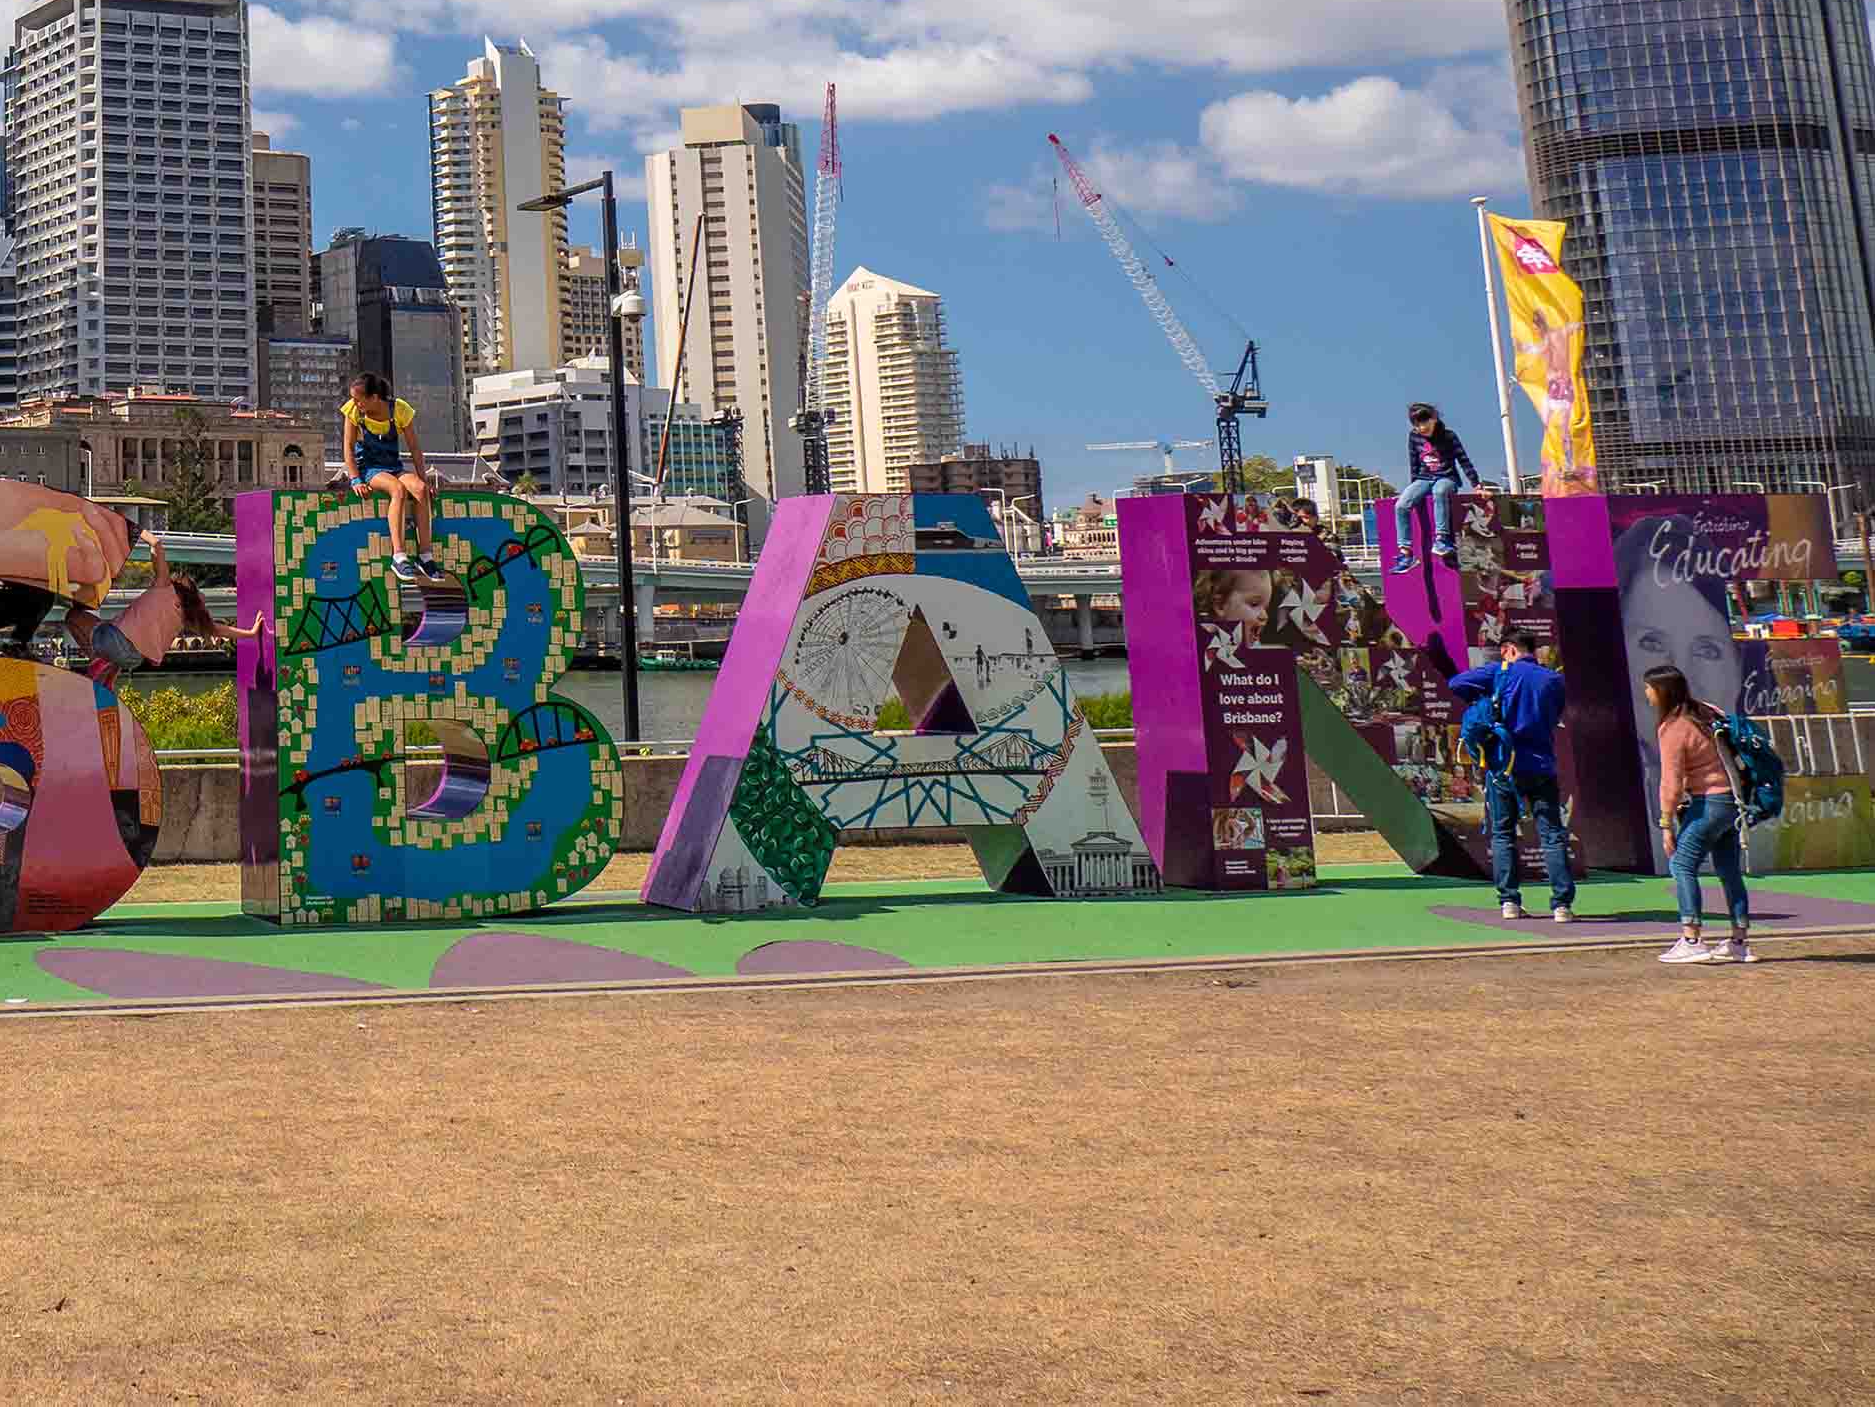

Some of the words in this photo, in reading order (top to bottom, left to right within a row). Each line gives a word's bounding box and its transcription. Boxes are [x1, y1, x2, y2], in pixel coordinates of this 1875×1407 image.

[1649, 520, 1812, 589] Educating
[1220, 674, 1254, 686] What
[1256, 674, 1272, 686] do
[1274, 674, 1280, 686] I
[1219, 692, 1245, 705] love
[1247, 692, 1284, 705] about
[1223, 711, 1283, 724] Brisbane?
